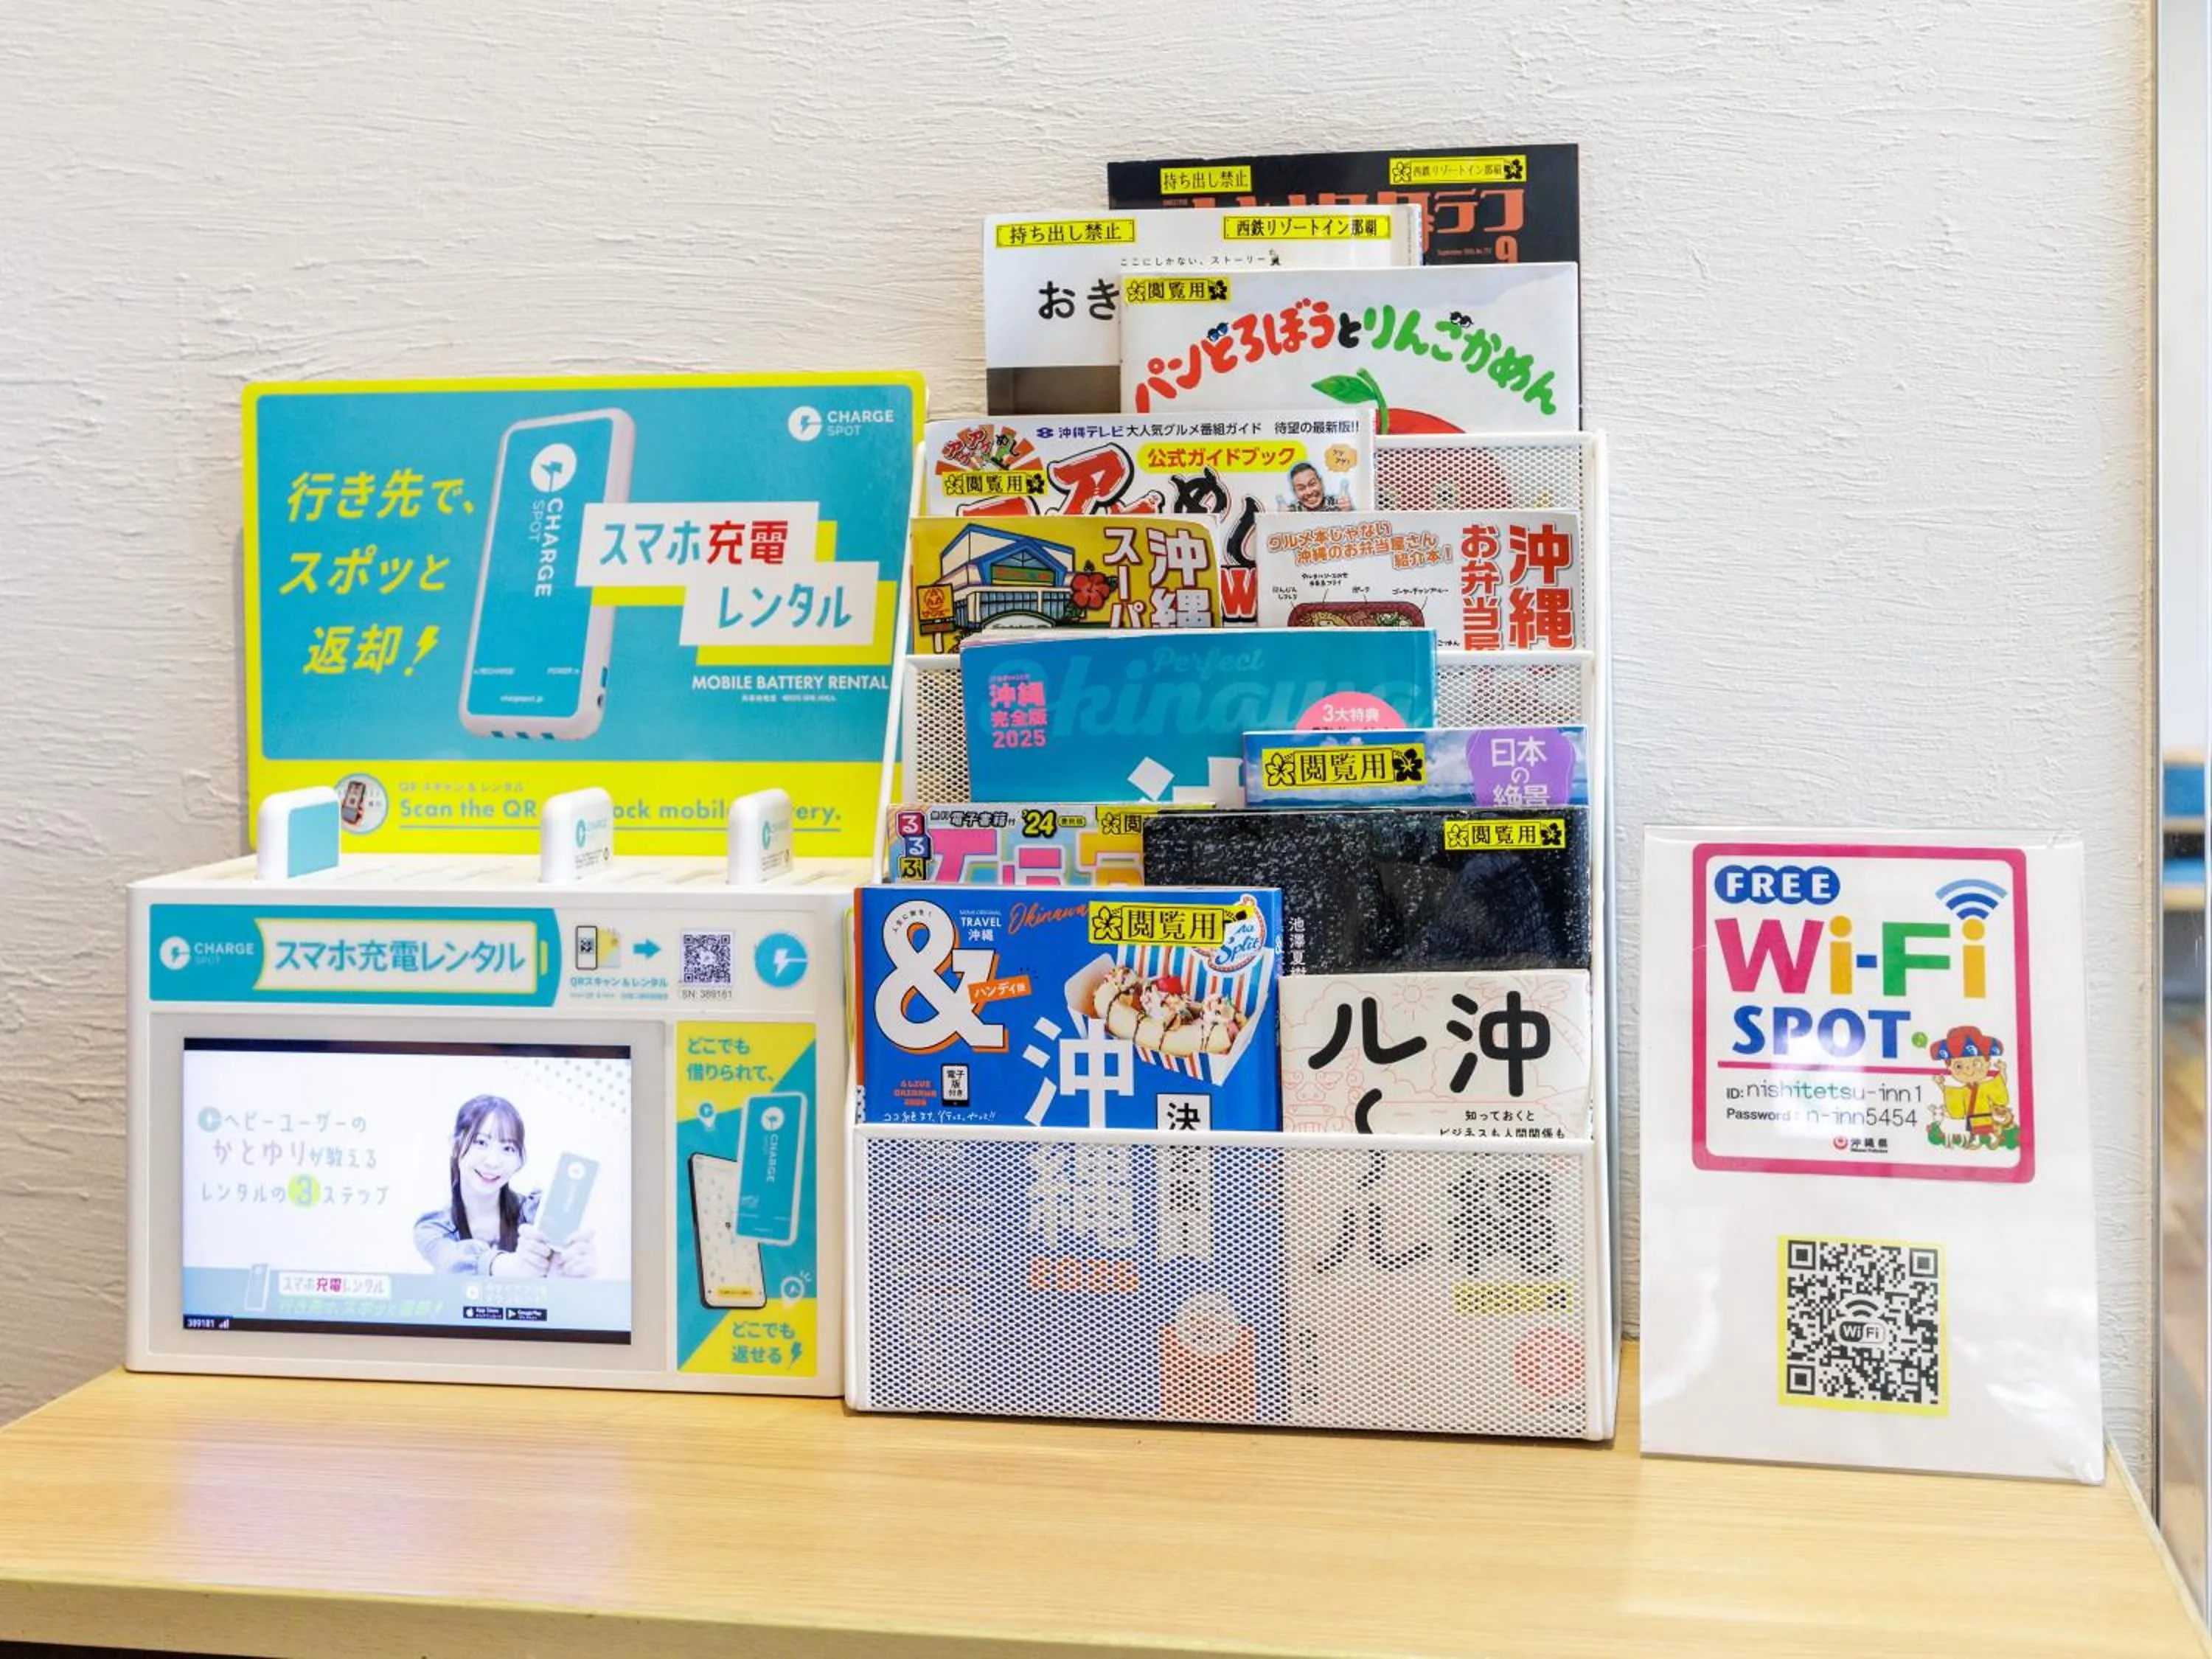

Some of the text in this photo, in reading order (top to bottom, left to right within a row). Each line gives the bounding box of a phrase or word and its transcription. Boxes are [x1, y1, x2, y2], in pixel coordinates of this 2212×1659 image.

[1163, 170, 1248, 190] 持ち出し禁止
[1009, 223, 1122, 244] 持ち出し禁止
[1237, 219, 1377, 237] 西鉄リゾートイン那覇
[1148, 279, 1205, 299] 閲覧用
[827, 410, 894, 423] CHARGE
[827, 425, 862, 437] SPOT
[1147, 446, 1295, 468] 公式ガイドブック
[966, 474, 1023, 493] 閲覧用
[287, 467, 475, 522] 行き先で、
[527, 499, 546, 543] SPOT
[534, 497, 564, 598] CHARGE
[599, 519, 789, 566] スマホ充電
[279, 544, 451, 594] スポッと
[1509, 523, 1573, 650] 沖縄
[717, 582, 853, 629] レンタル
[692, 675, 890, 690] MOBILE BATTERY RENTAL
[990, 681, 1046, 709] 沖縄
[1322, 703, 1380, 723] 3大特典
[992, 728, 1046, 749] 2025
[1490, 735, 1547, 768] 日本
[1300, 752, 1386, 783] 閲覧用
[400, 799, 452, 818] Scan
[460, 800, 494, 818] the
[503, 800, 538, 818] QR
[613, 799, 651, 820] ock
[659, 799, 726, 821] mobil
[1472, 824, 1536, 845] 閲覧用
[900, 814, 926, 880] るるぶ
[1725, 872, 1832, 899] FREE
[961, 917, 1002, 928] TRAVEL
[1127, 909, 1216, 941] 閲覧用
[968, 929, 994, 942] 沖縄
[195, 942, 255, 956] CHARGE
[275, 939, 526, 973] スマホ充電レンタル
[1714, 915, 1986, 999] Wi-Fi
[874, 899, 1009, 1055] &
[1731, 1005, 1912, 1060] SPOT
[686, 1037, 751, 1056] どこでも
[686, 1063, 777, 1082] 借りられて、
[1726, 1088, 1745, 1100] ID:
[1464, 1109, 1535, 1121] 知っておくと
[731, 1321, 796, 1339] どこでも
[731, 1343, 782, 1364] 返せる
